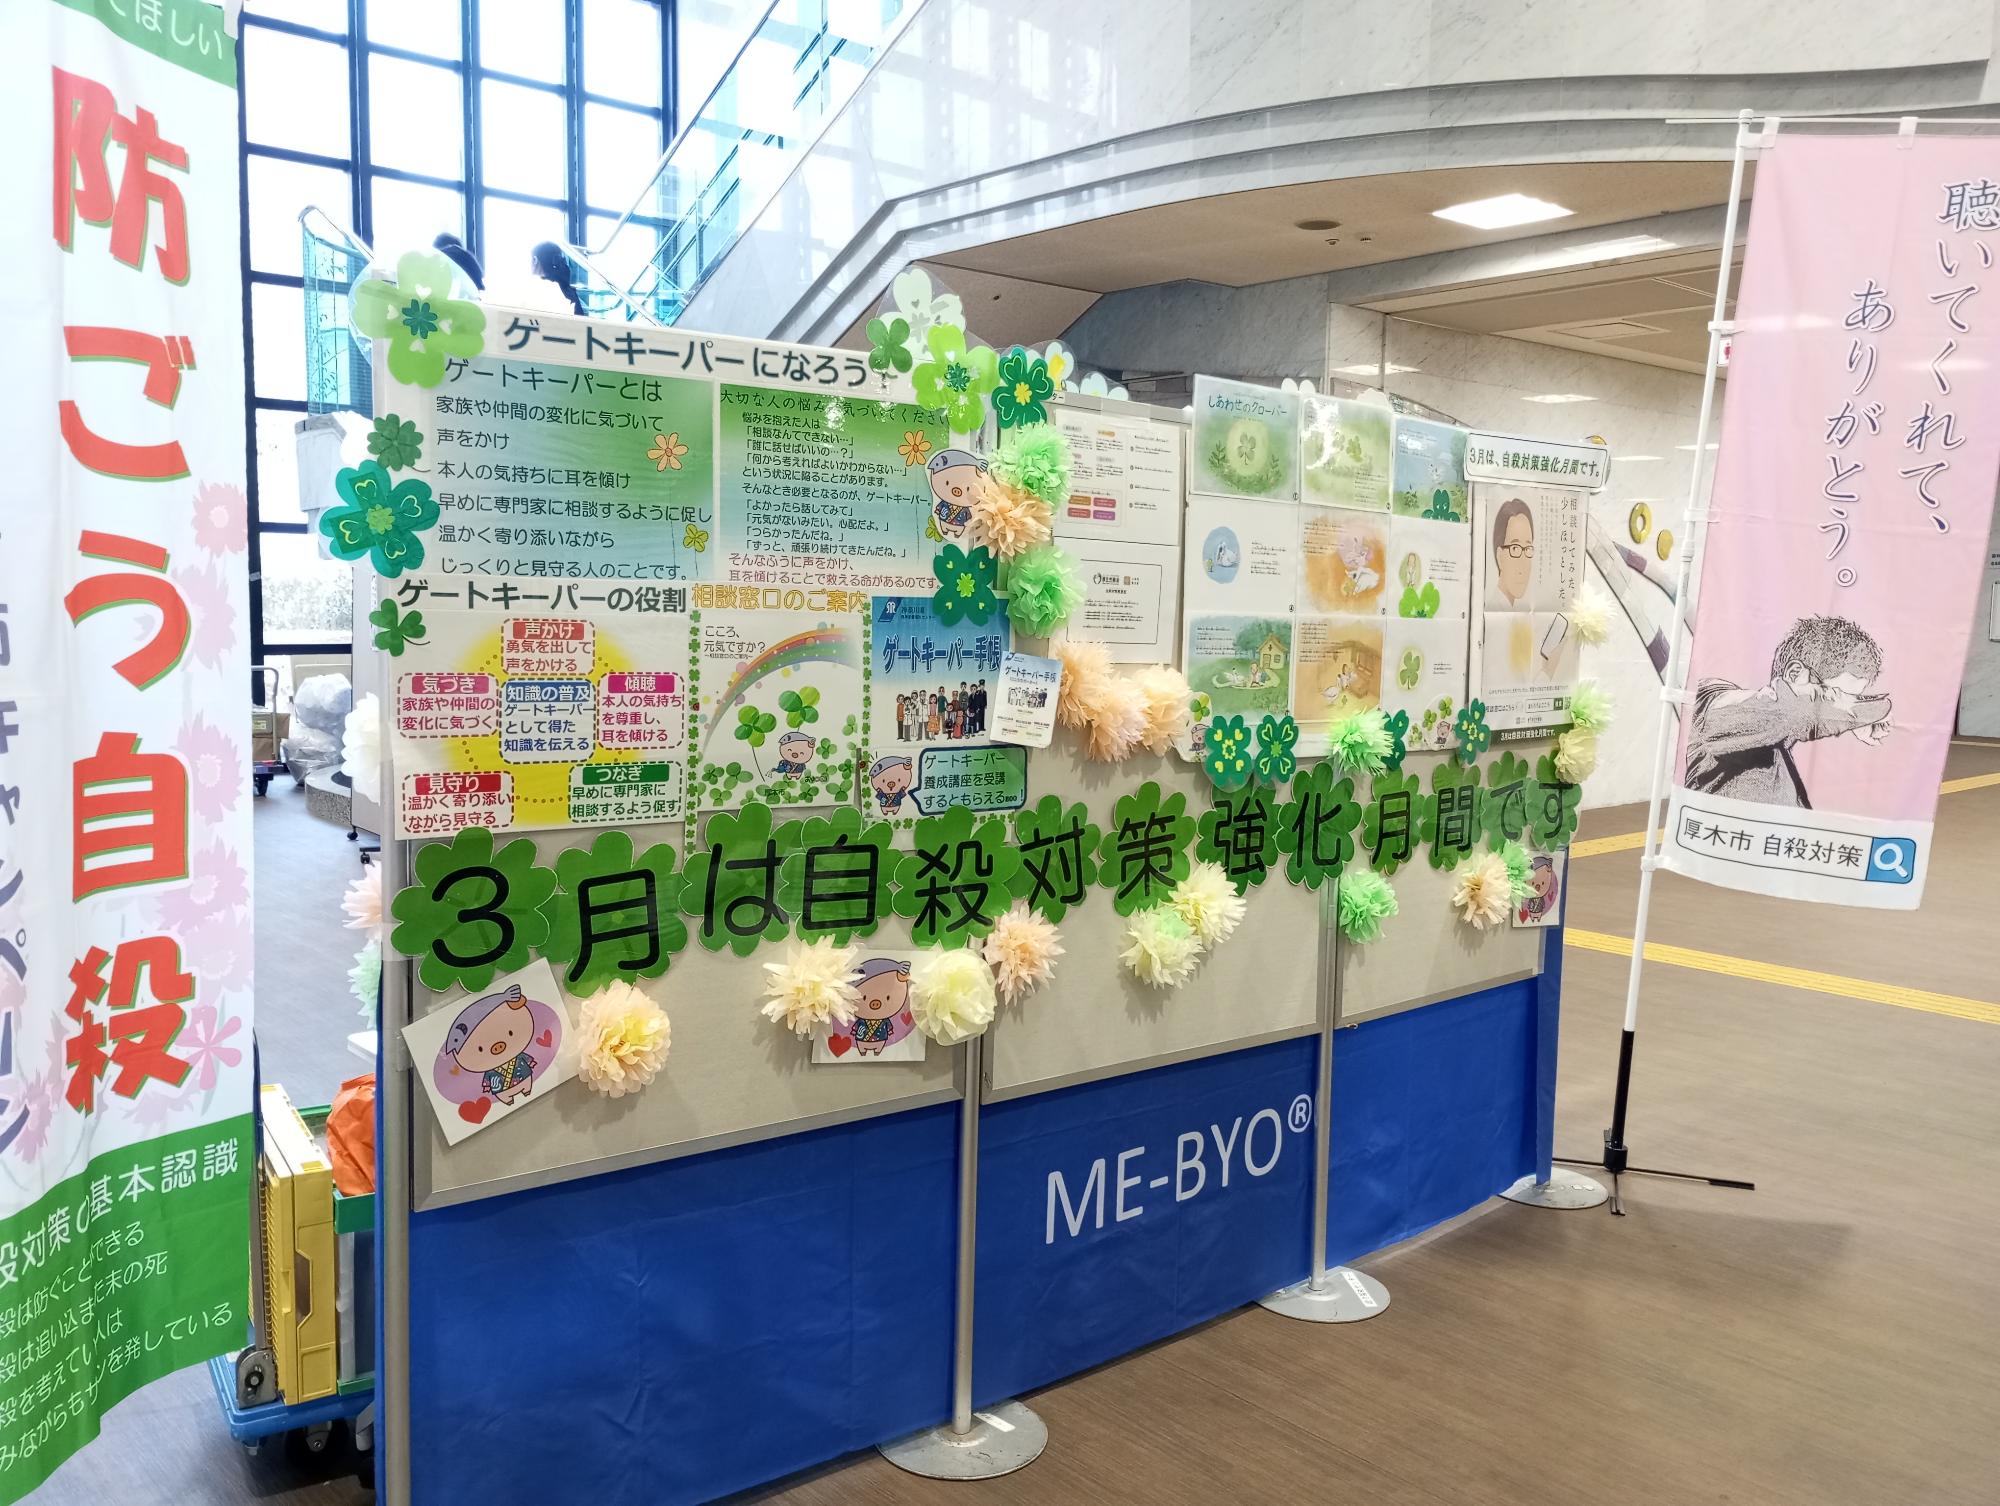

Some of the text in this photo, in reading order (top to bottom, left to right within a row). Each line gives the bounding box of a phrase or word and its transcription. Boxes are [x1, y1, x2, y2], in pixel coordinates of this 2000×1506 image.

[503, 317, 867, 387] ゲートキーパーになろう
[1898, 177, 2000, 535] 聴いてくれて、
[445, 357, 663, 402] ゲートキーパーとは
[436, 395, 664, 432] 家族や仲間の変化に気づいて
[720, 390, 950, 427] 大切な人の悩み気づいてください
[1208, 394, 1288, 416] しあわせのクローバー
[742, 412, 820, 429] 悩みを抱えた人は
[437, 428, 510, 450] 声をかけ
[1817, 278, 1896, 588] ありがとう。
[1469, 447, 1600, 478] 3月は、自殺対策強化月間です。
[437, 462, 631, 489] 本人の気持ちに耳を傾け
[742, 467, 889, 488] という状況に陥ることがあります。
[742, 483, 932, 507] そんなとき必要となるのが、ゲートキーパー。
[439, 492, 712, 523] 早めに専門家に相談するように促し
[747, 500, 853, 516] 「よかったら話してみて」
[747, 514, 889, 532] 「元気がないみたい。心配だよ。」
[438, 525, 615, 549] 温かく寄り添いながら
[747, 527, 845, 541] 「つらかったんだね。」
[441, 558, 688, 581] じっくりと見守る人のことです。
[728, 553, 853, 571] そんなふうに声をかけ、
[728, 569, 941, 590] 耳を傾けることで救える命があるのです。
[53, 64, 196, 1118] 防ごう自殺
[397, 579, 687, 613] ゲートキーパーの役割
[689, 583, 867, 613] 相談窓口のご案内
[524, 622, 575, 638] 声かけ
[705, 626, 740, 638] こころ、
[506, 639, 592, 655] 勇気を出して
[882, 634, 1001, 673] ゲートキーパー手帳
[505, 658, 578, 672] 声をかける
[422, 677, 476, 693] 気づき
[507, 683, 591, 701] 知識の普及
[624, 677, 656, 692] 傾聴
[402, 697, 496, 712] 家族や仲間の
[504, 703, 596, 717] ゲートキーパー
[601, 695, 682, 708] 本人の気持ち
[402, 715, 494, 731] 変化に気づく
[505, 720, 576, 734] として得た
[602, 711, 662, 725] を尊重し、
[504, 737, 589, 752] 知識を伝える
[601, 729, 668, 742] 耳を傾ける
[925, 754, 1006, 769] ゲートキーパー
[596, 767, 643, 782] つなぎ
[924, 771, 1006, 789] 養成講座を受講
[428, 776, 480, 793] 見守り
[572, 783, 666, 800] 早めに専門家に
[408, 792, 512, 810] 温かく寄り添い
[571, 799, 679, 818] 相談するよう促す
[408, 811, 497, 829] ながら見守る
[1683, 817, 1864, 868] 厚木市 自殺対策
[431, 778, 1575, 983] 3月は自殺対策強化月間です
